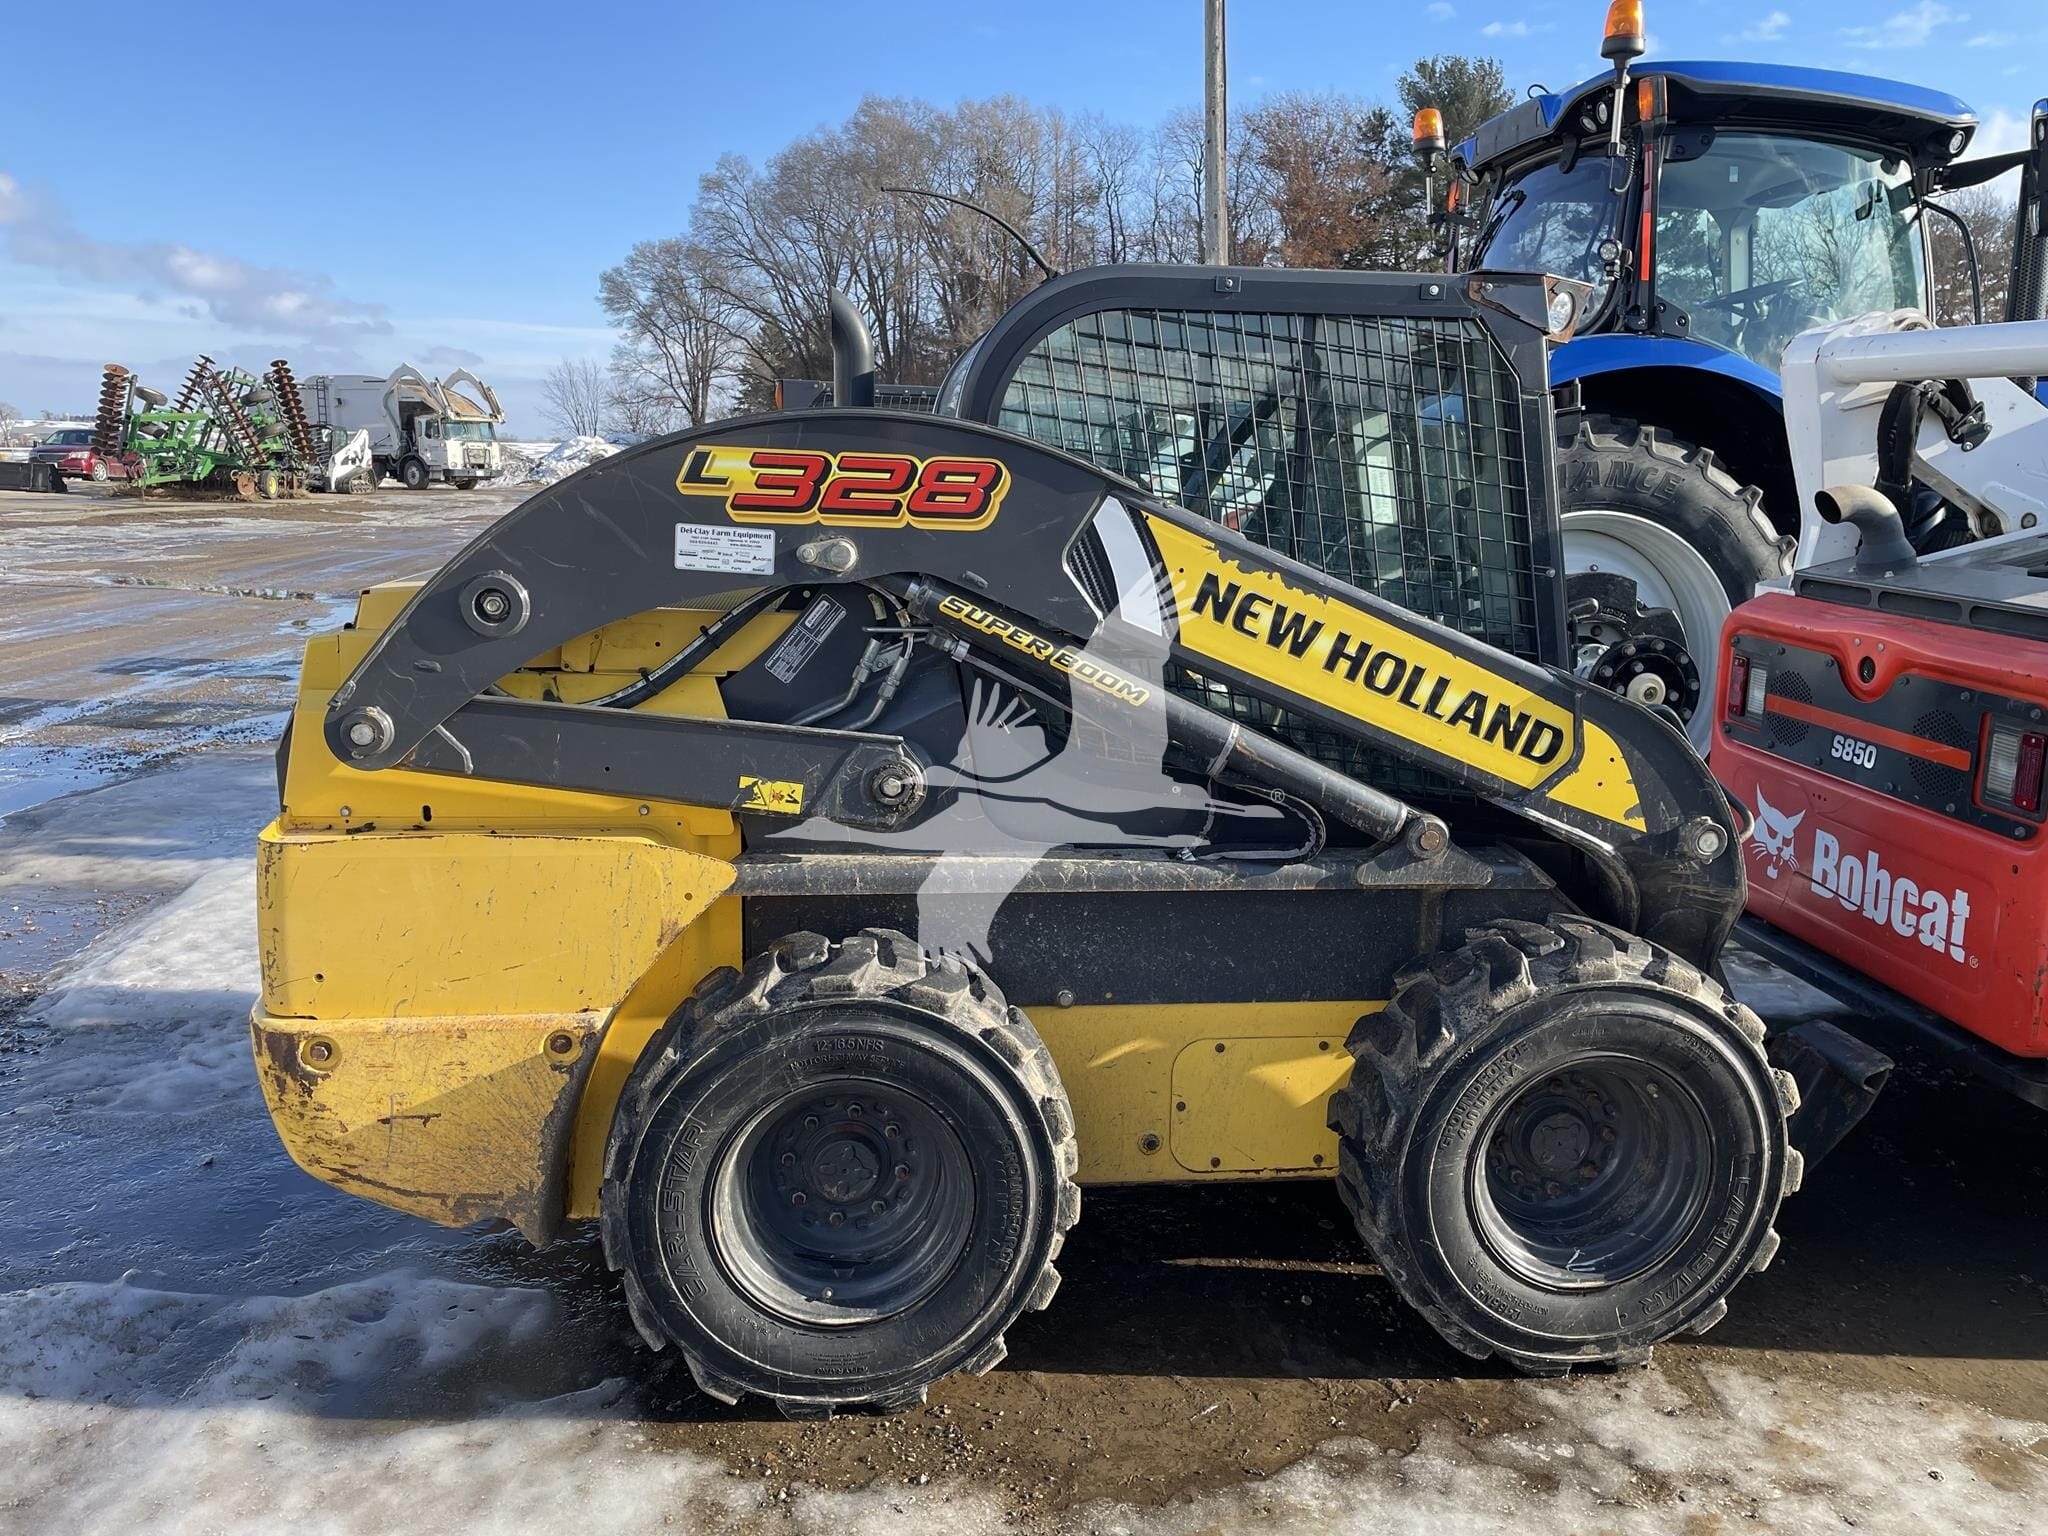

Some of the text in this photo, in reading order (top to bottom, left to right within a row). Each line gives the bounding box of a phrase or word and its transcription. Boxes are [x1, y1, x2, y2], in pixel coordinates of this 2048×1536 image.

[680, 449, 1004, 518] L328
[680, 527, 772, 540] Del-Clay Farm Equipment
[940, 597, 1148, 704] SUPER BOOM
[1190, 572, 1564, 765] NEW HOLLAND
[1831, 735, 1877, 769] S850
[1811, 829, 1970, 963] Bobcat
